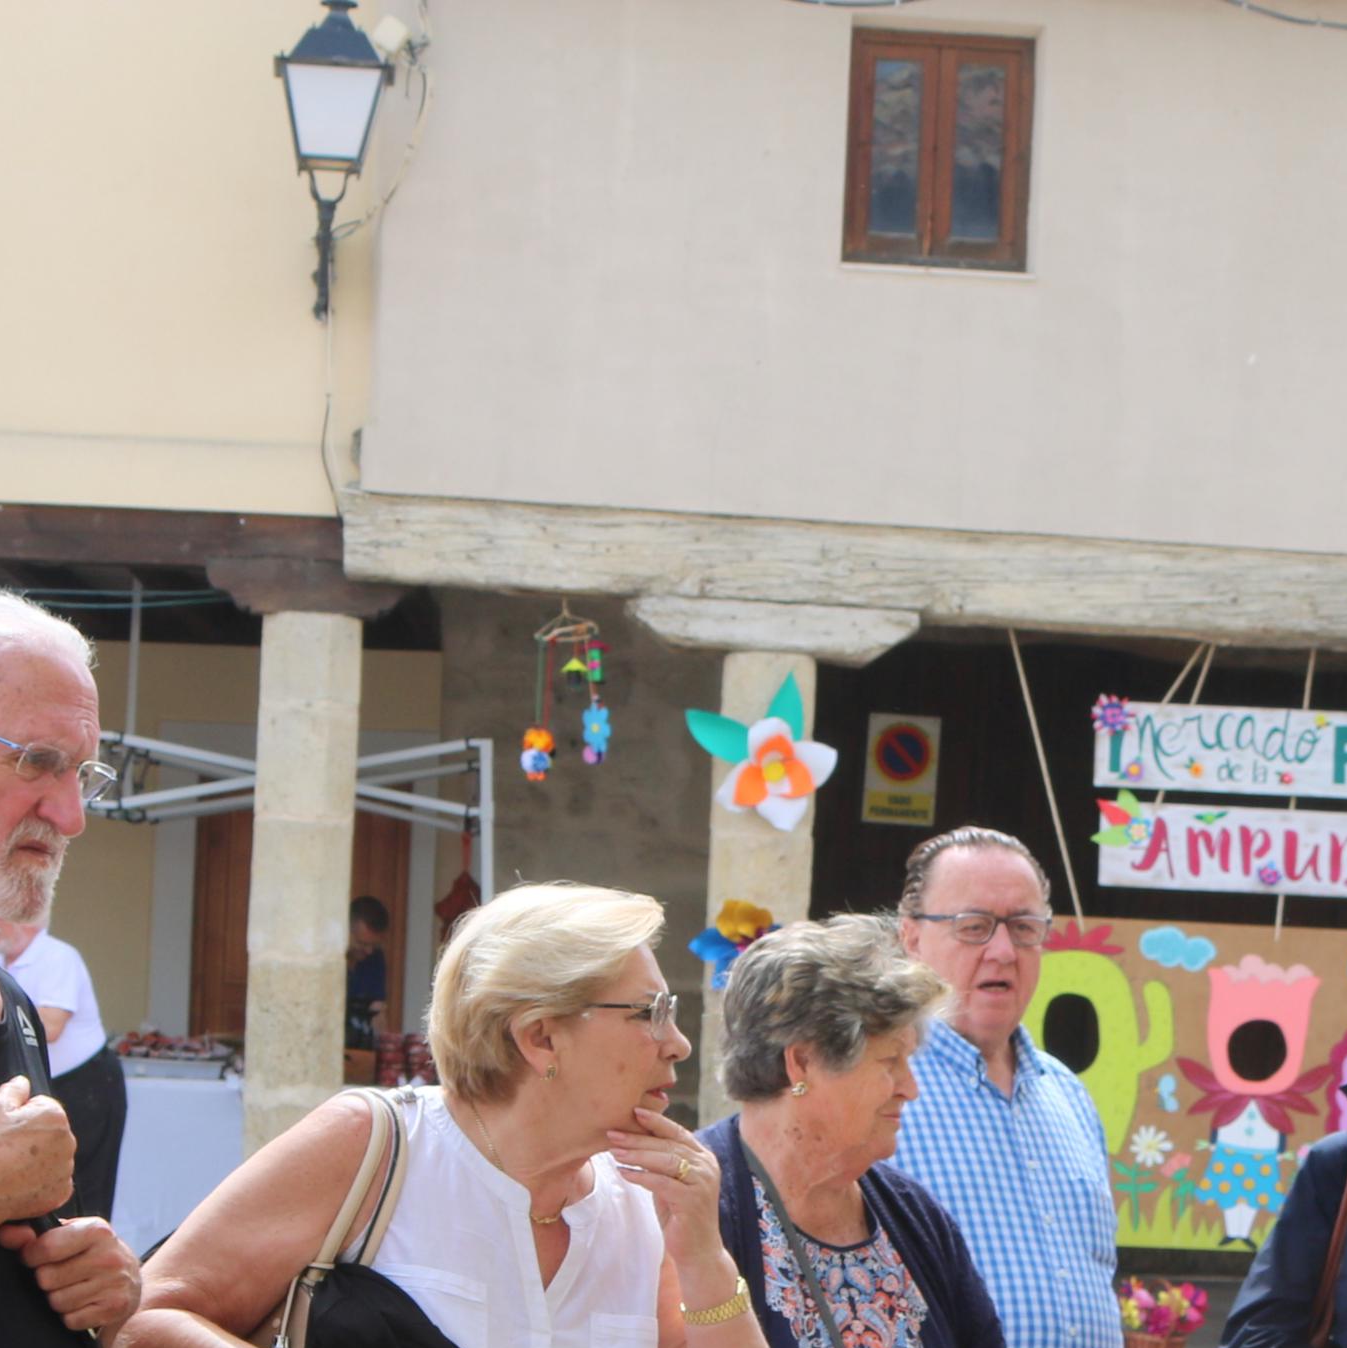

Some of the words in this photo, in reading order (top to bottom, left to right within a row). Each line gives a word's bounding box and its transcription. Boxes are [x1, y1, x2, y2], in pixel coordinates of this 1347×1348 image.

[1108, 709, 1321, 782] Mercado
[1216, 756, 1243, 784] de
[1253, 757, 1269, 784] la
